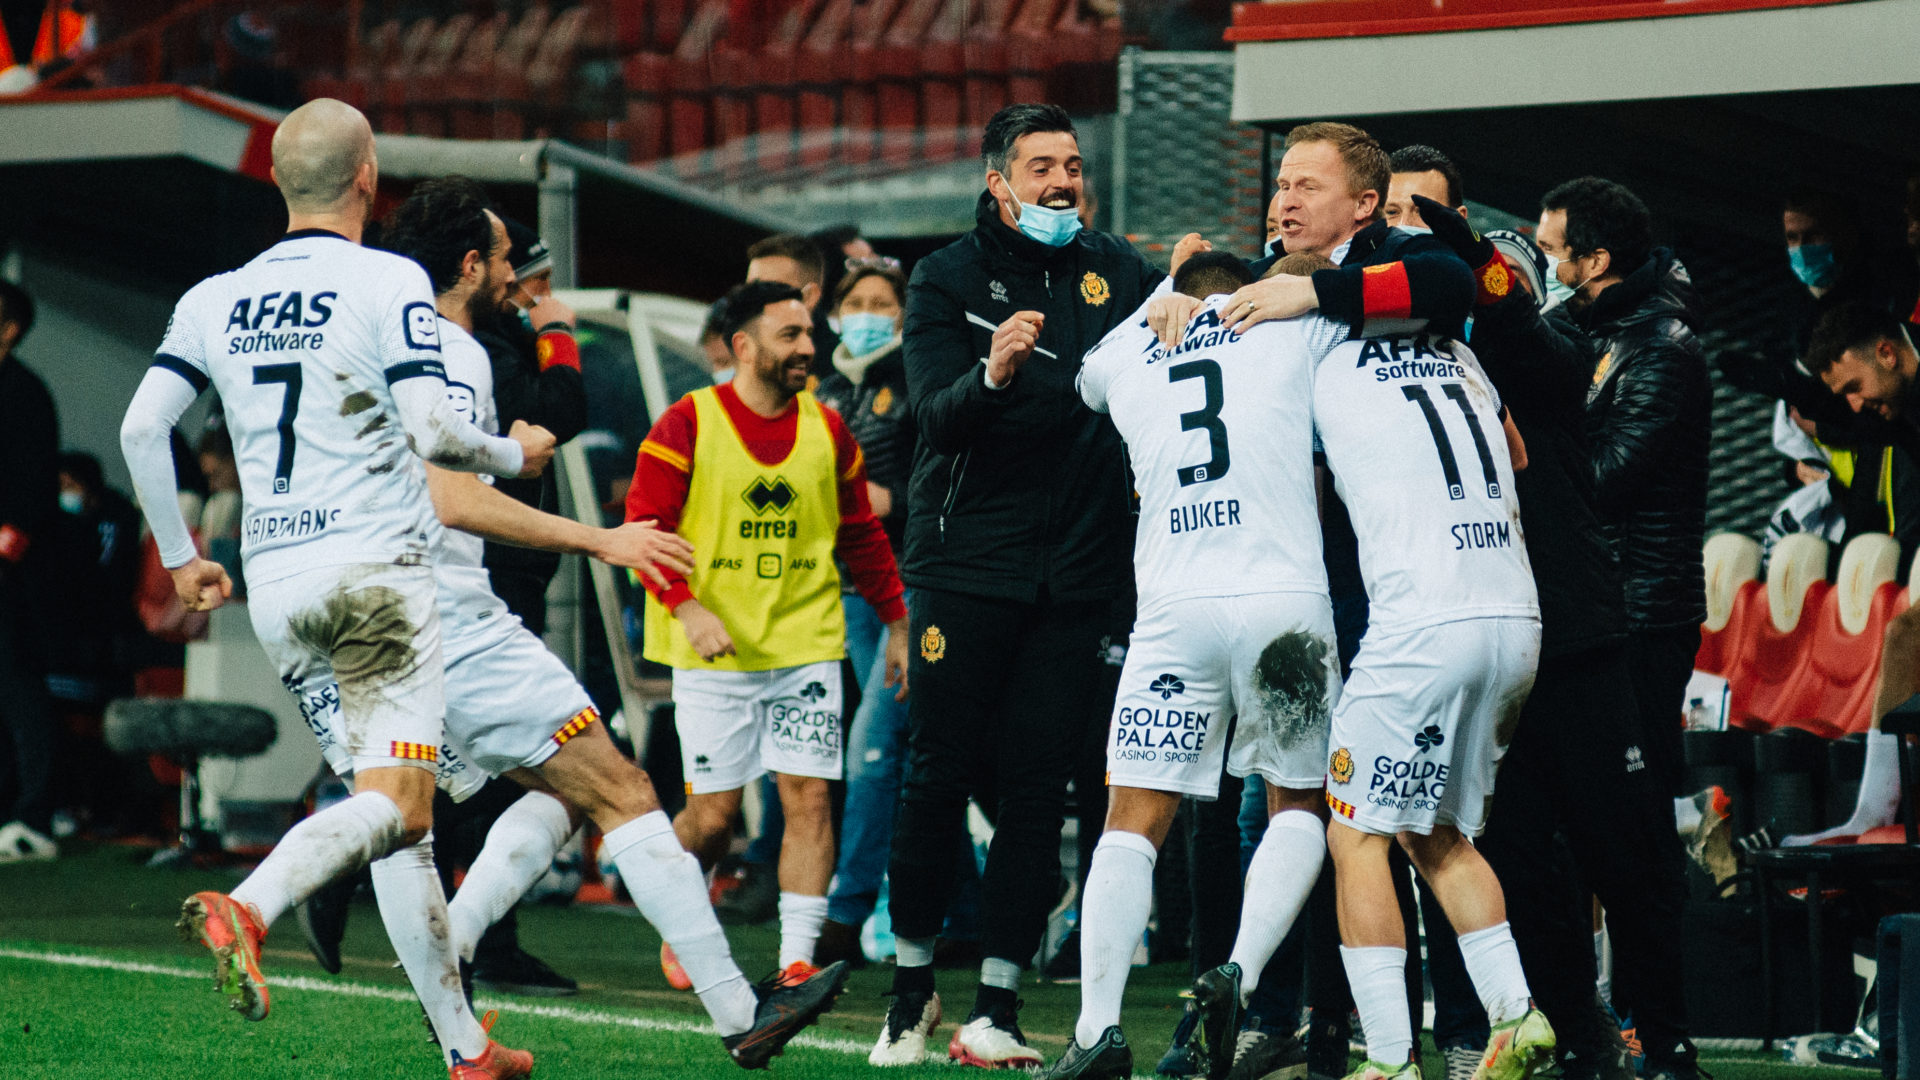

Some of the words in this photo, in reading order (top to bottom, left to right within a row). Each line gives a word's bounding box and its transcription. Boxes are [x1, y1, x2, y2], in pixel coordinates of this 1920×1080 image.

[224, 290, 338, 334] AFAS
[228, 330, 323, 355] software
[1356, 336, 1458, 369] AFAS
[1375, 361, 1466, 382] software
[252, 363, 302, 494] 7
[1169, 358, 1231, 488] 3
[1400, 383, 1502, 501] 11
[1170, 499, 1242, 534] BIJKER
[1451, 521, 1511, 550] STORM
[790, 558, 817, 570] AFAS
[1119, 707, 1210, 731] GOLDEN
[1117, 728, 1206, 751] PALACE
[1115, 749, 1157, 761] CASINO
[1164, 751, 1200, 763] SPORTS
[1374, 755, 1450, 782] GOLDE
[1370, 773, 1446, 800] PALAC
[1367, 793, 1409, 811] CASINO
